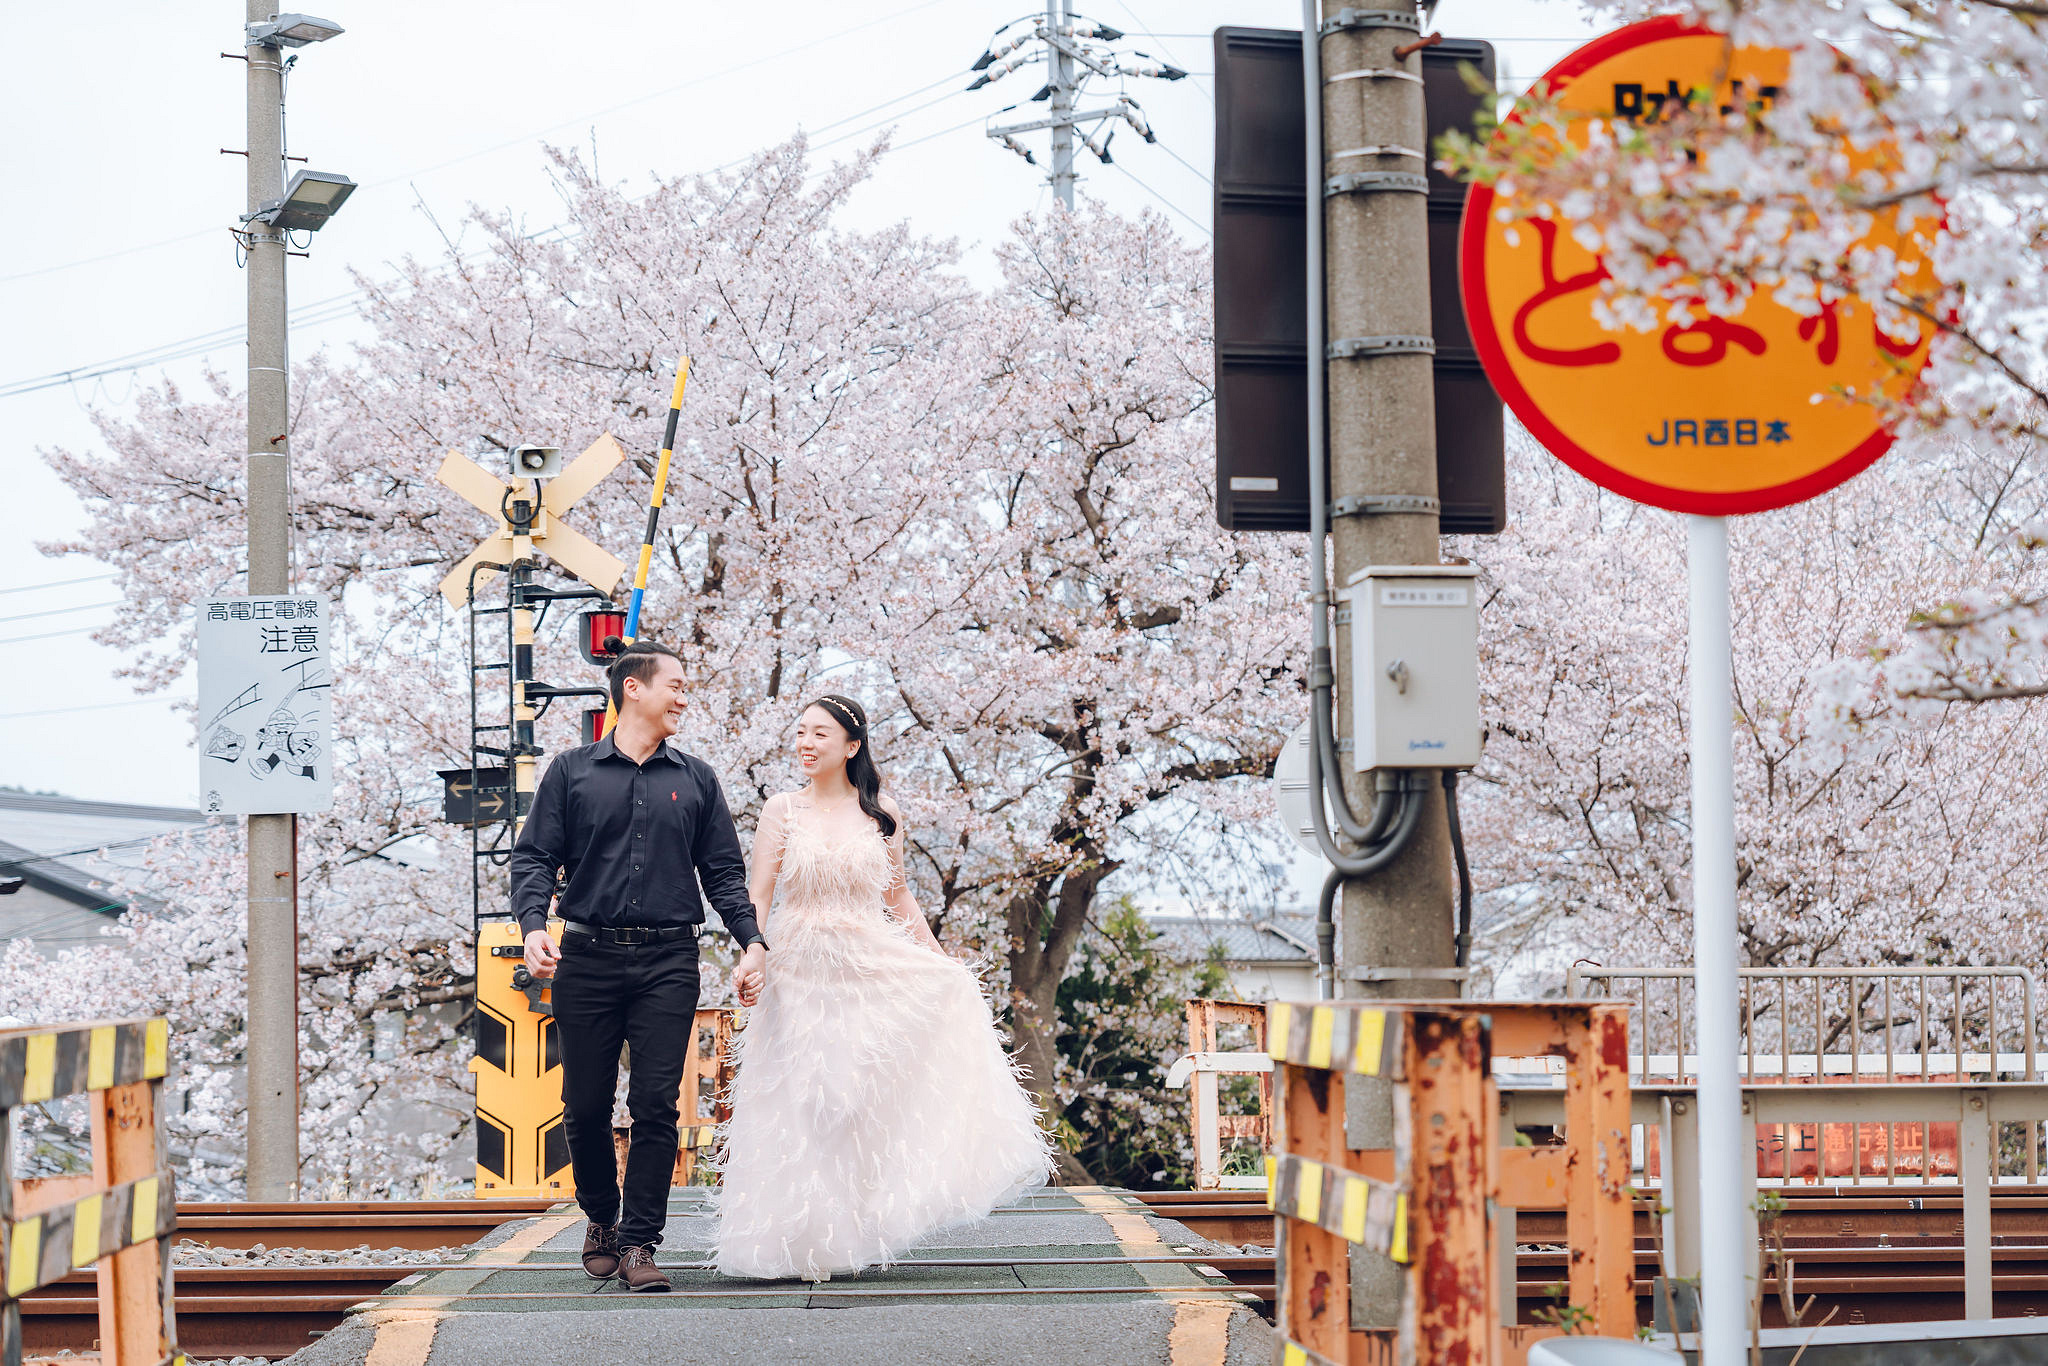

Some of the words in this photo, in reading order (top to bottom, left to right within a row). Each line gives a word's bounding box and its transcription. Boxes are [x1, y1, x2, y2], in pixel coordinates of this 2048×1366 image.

[1646, 419, 1791, 447] JR西日本
[207, 600, 319, 622] 高電圧電線
[261, 624, 319, 653] 注意
